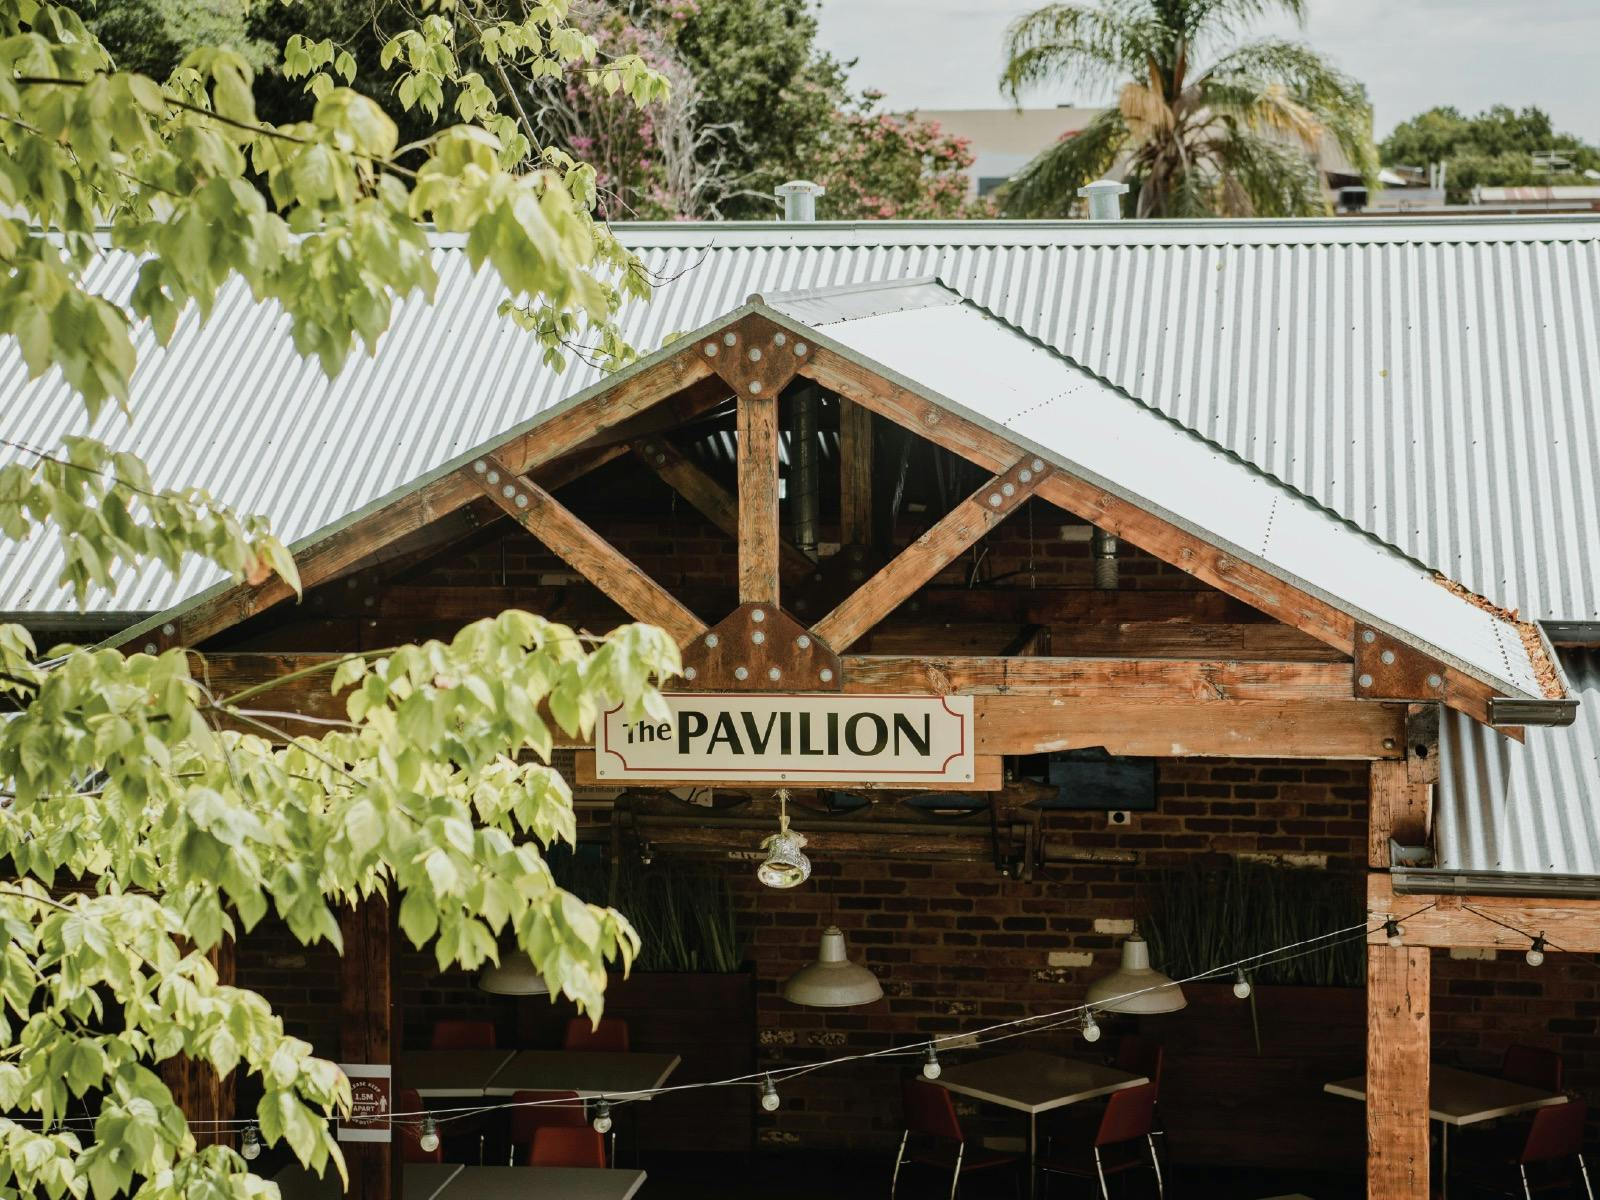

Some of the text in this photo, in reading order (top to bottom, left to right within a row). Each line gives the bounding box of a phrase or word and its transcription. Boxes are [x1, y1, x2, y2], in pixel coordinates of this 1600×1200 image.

[622, 711, 930, 756] The PAVILION
[355, 1093, 374, 1101] 1.5M
